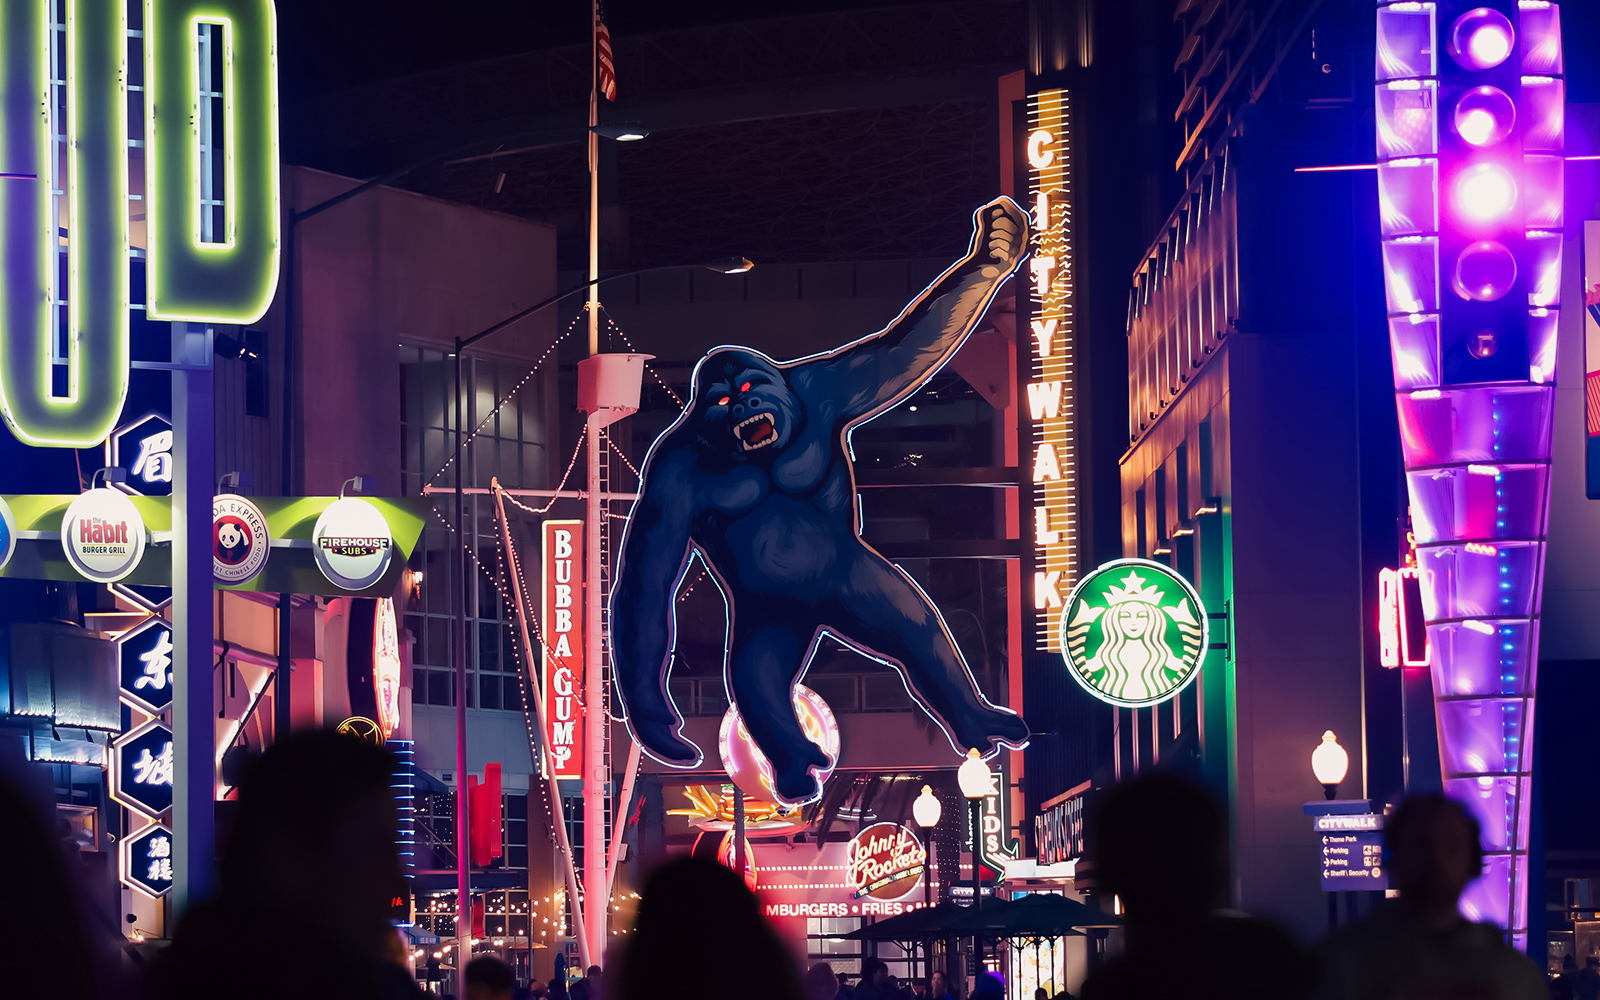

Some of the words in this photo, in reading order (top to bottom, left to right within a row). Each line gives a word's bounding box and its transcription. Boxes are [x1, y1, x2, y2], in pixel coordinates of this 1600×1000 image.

[1026, 129, 1063, 611] CITYWALK
[80, 519, 128, 543] Habit
[230, 503, 264, 539] EXPRESS
[320, 538, 388, 550] FIREHOUSE
[341, 547, 367, 555] SUBS
[224, 566, 250, 576] CHINESE
[250, 547, 262, 565] FOOD
[554, 529, 573, 657] BUBBA
[552, 667, 574, 769] GUMP
[1318, 817, 1376, 829] CITYWALK
[846, 829, 914, 886] Johnny
[1330, 847, 1349, 855] Parking
[854, 845, 928, 887] Rockets
[862, 903, 903, 915] FRIES
